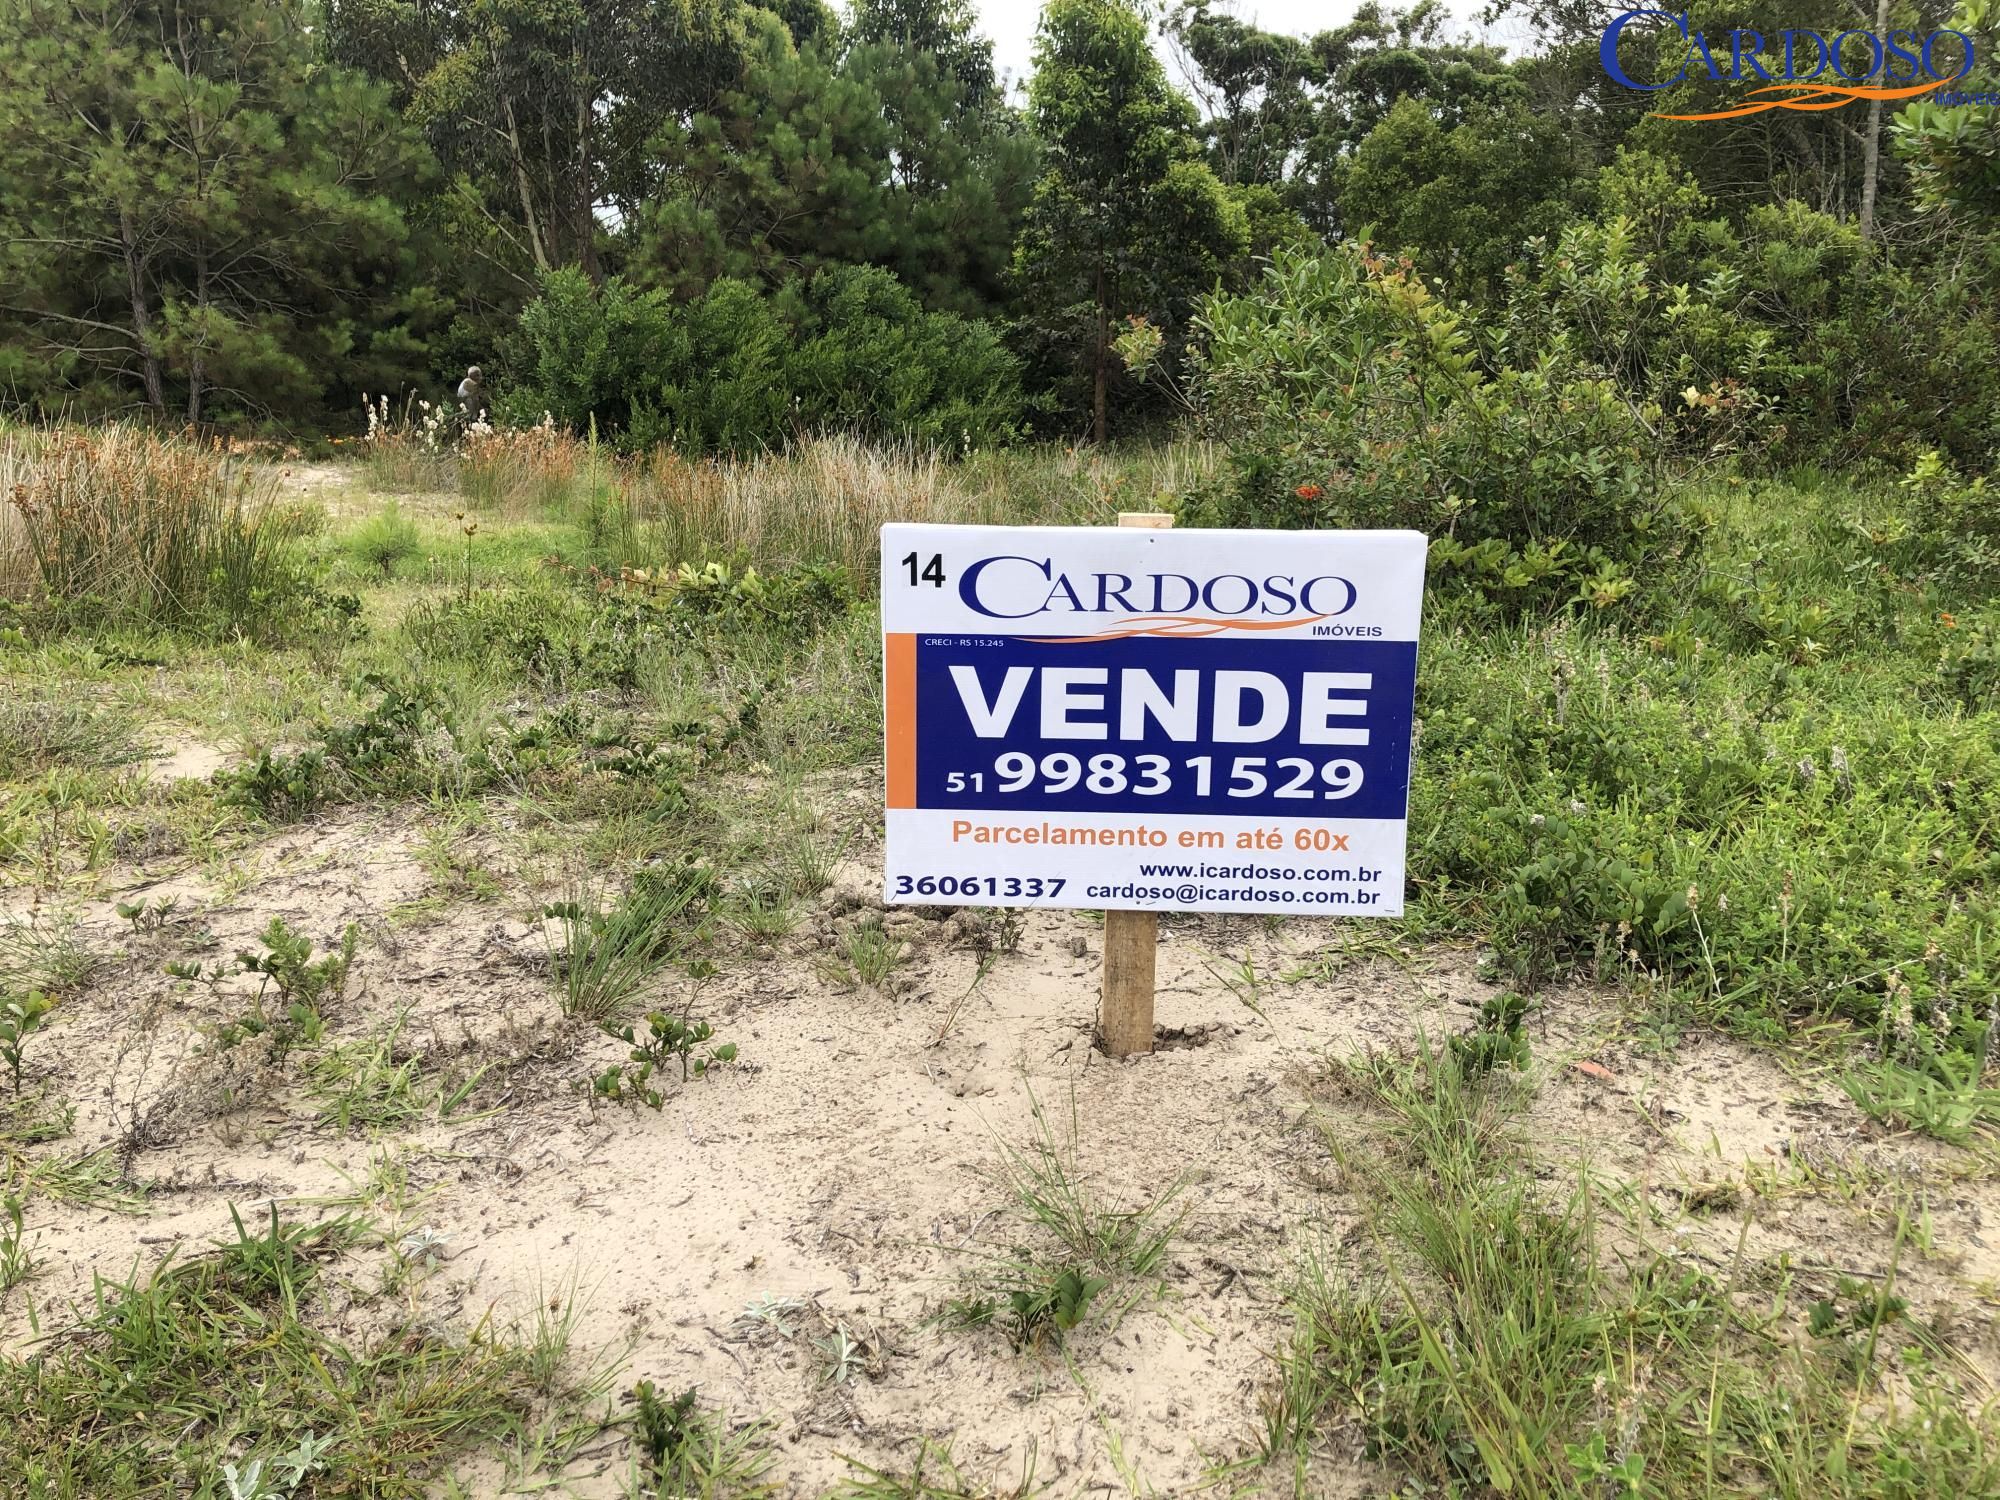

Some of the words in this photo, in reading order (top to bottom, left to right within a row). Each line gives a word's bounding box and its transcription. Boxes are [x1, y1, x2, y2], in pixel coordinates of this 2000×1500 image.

[902, 552, 946, 588] 14
[959, 557, 1357, 618] CARDOSO
[1311, 622, 1383, 637] IMÓVEIS
[924, 638, 952, 646] CRECI
[959, 639, 972, 647] RS
[974, 639, 1004, 647] 15.245
[948, 665, 1373, 746] VENDE
[946, 772, 984, 793] 51
[994, 751, 1364, 800] 99831529
[952, 820, 1168, 847] Parcelamento
[1178, 831, 1225, 849] em
[1236, 827, 1283, 850] até
[1294, 828, 1350, 852] 60x
[1139, 861, 1382, 883] www.icardoso.com.br
[895, 875, 1067, 898] 36061337
[1086, 883, 1381, 905] cardoso@icardoso.com.br
